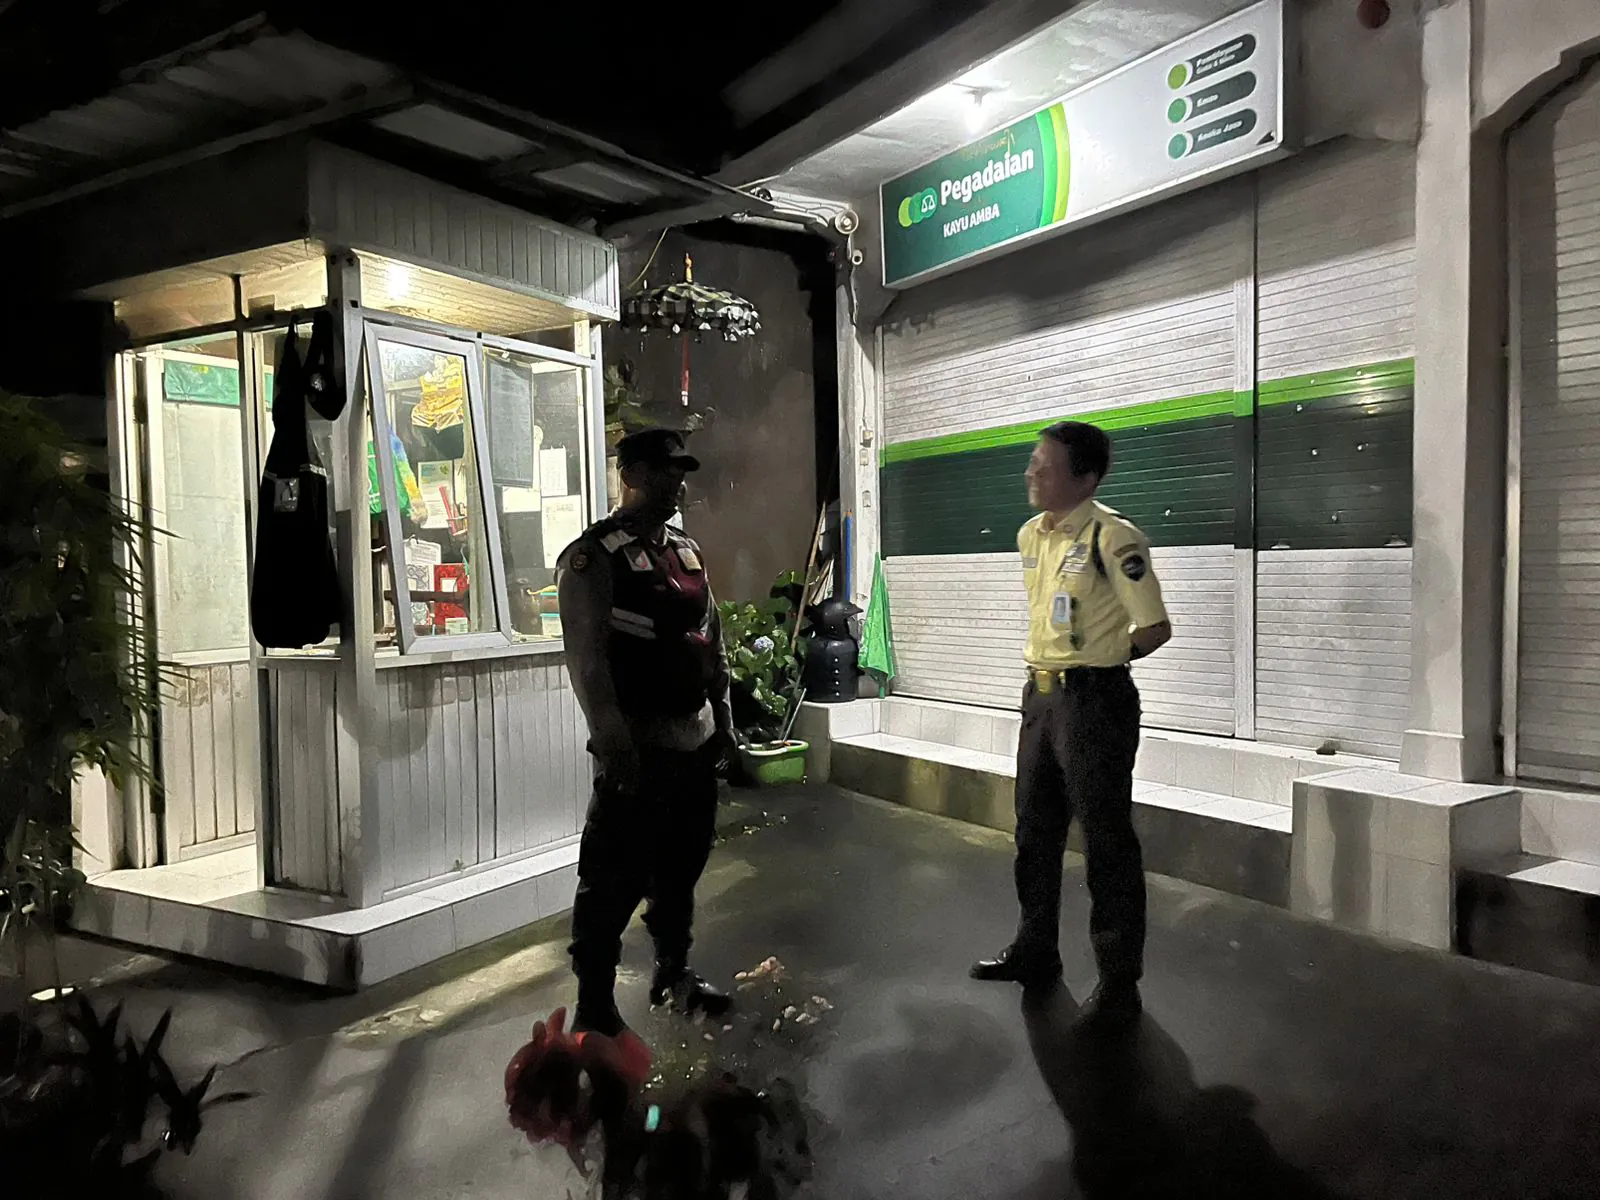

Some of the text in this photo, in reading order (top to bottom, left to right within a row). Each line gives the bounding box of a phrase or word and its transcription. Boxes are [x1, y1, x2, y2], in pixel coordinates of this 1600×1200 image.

[941, 148, 1034, 206] Pegadaian
[943, 203, 1000, 238] KAYU AMBA
